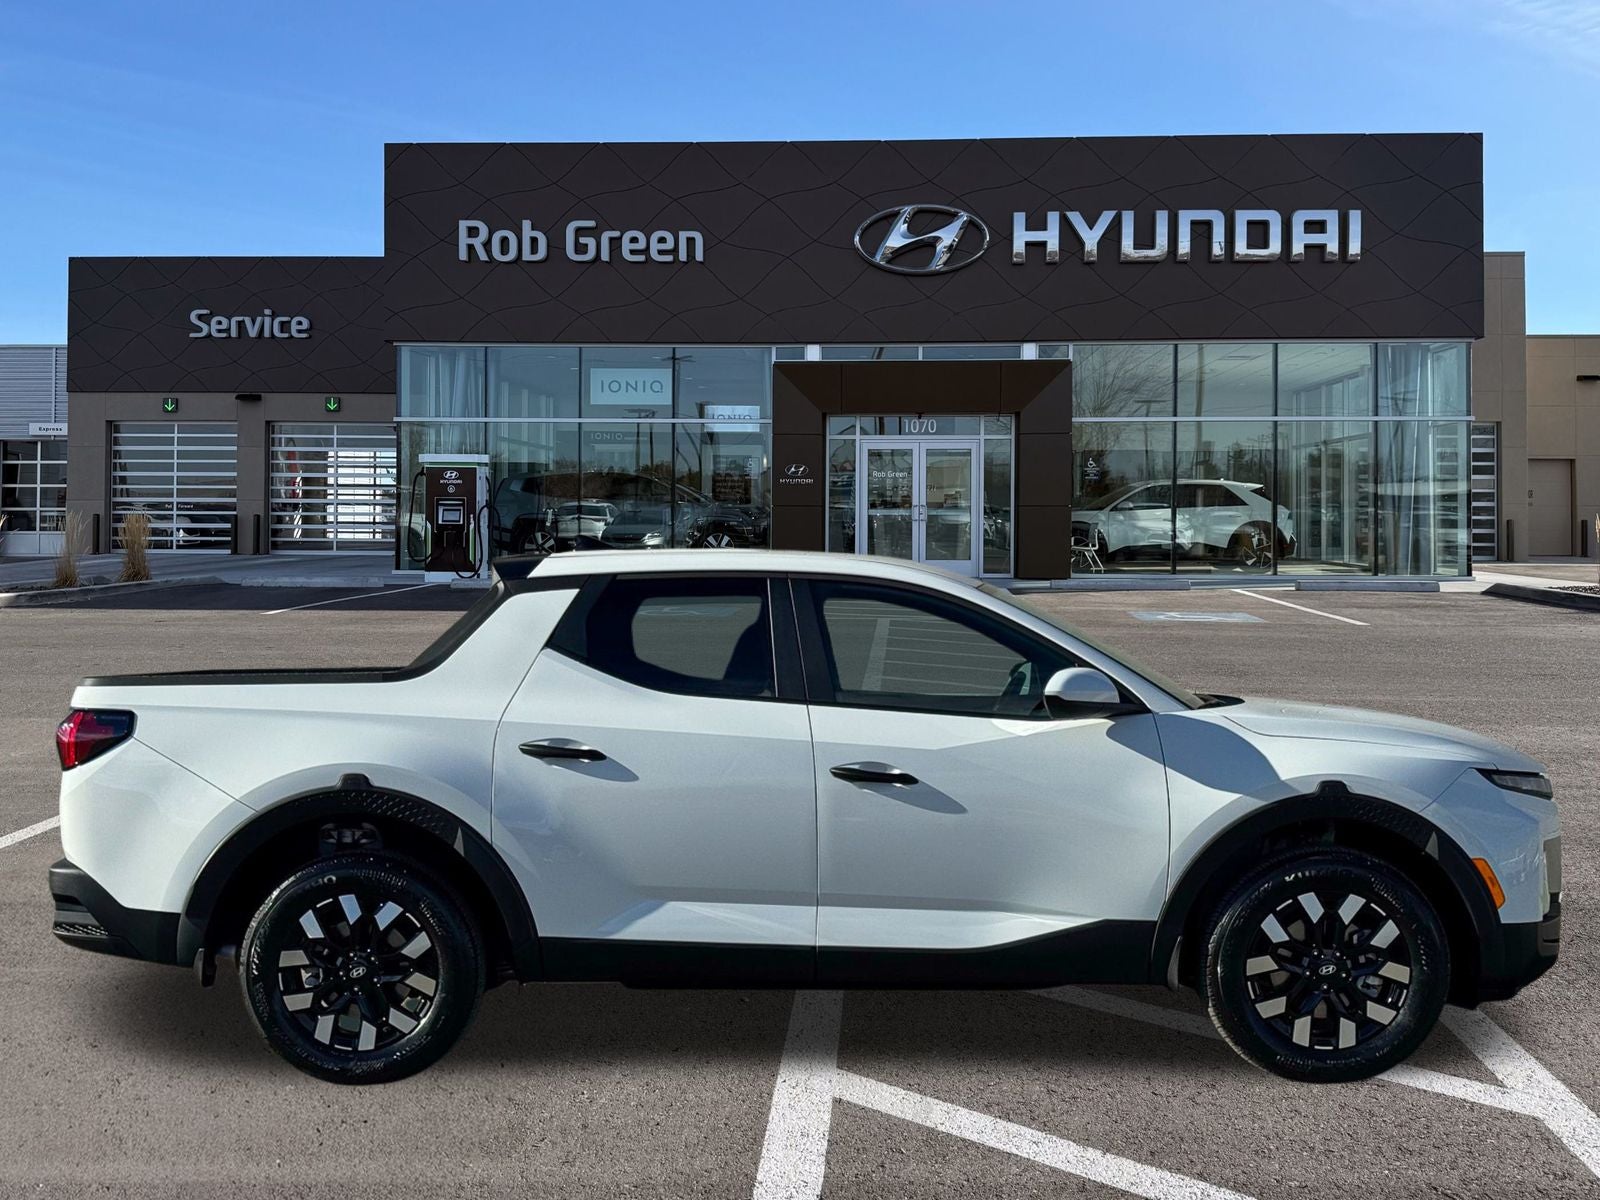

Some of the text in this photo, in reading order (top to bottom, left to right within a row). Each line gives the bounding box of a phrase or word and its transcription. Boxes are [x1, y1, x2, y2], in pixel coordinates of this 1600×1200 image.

[458, 219, 705, 263] Rob Green
[1011, 209, 1362, 264] HYUNDAI
[189, 309, 311, 339] Service
[600, 379, 664, 394] IONIQ
[903, 419, 937, 433] 1070
[872, 470, 908, 478] Rob Green
